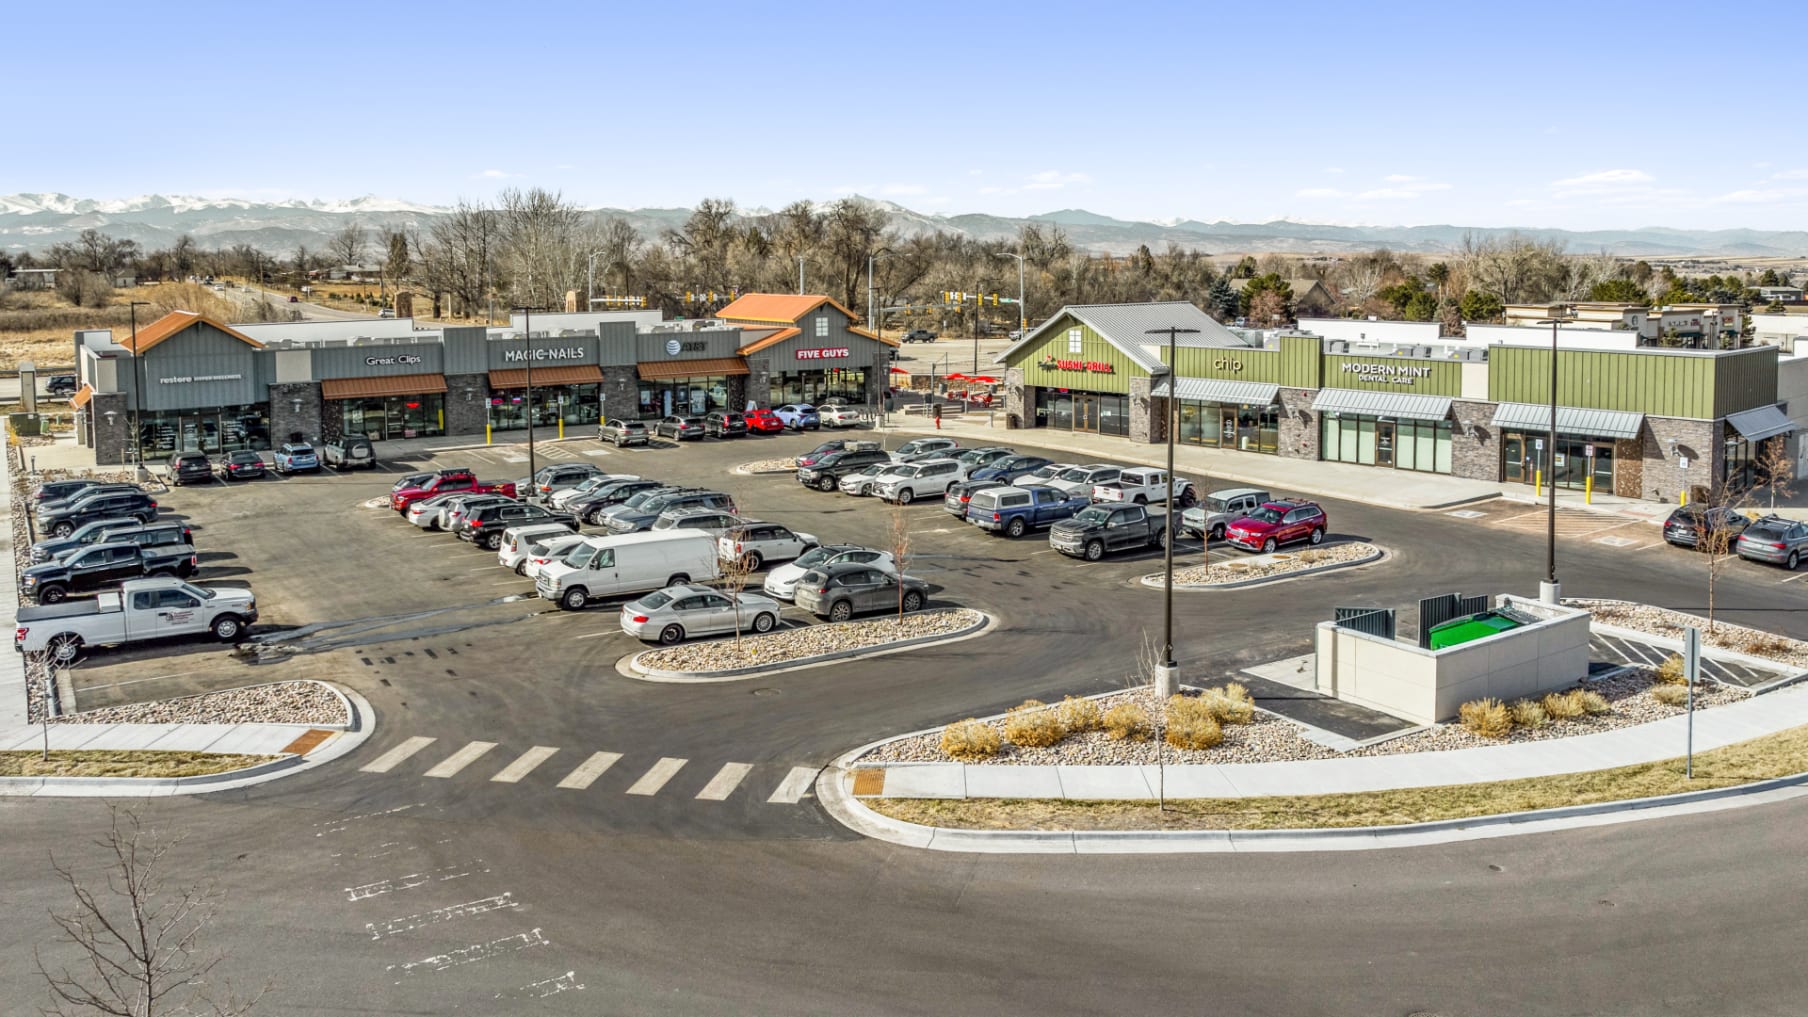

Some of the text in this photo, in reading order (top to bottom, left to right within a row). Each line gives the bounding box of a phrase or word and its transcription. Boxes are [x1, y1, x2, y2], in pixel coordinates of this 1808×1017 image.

[548, 347, 585, 360] NAILS
[797, 348, 849, 360] FIVE GUYS
[366, 355, 421, 366] Great Clips
[1056, 360, 1113, 373] SUSHI GRILL
[1213, 356, 1243, 374] chip
[1342, 362, 1432, 378] MODERN MINT
[159, 376, 192, 385] restore
[1358, 374, 1414, 385] DENTAL CARE
